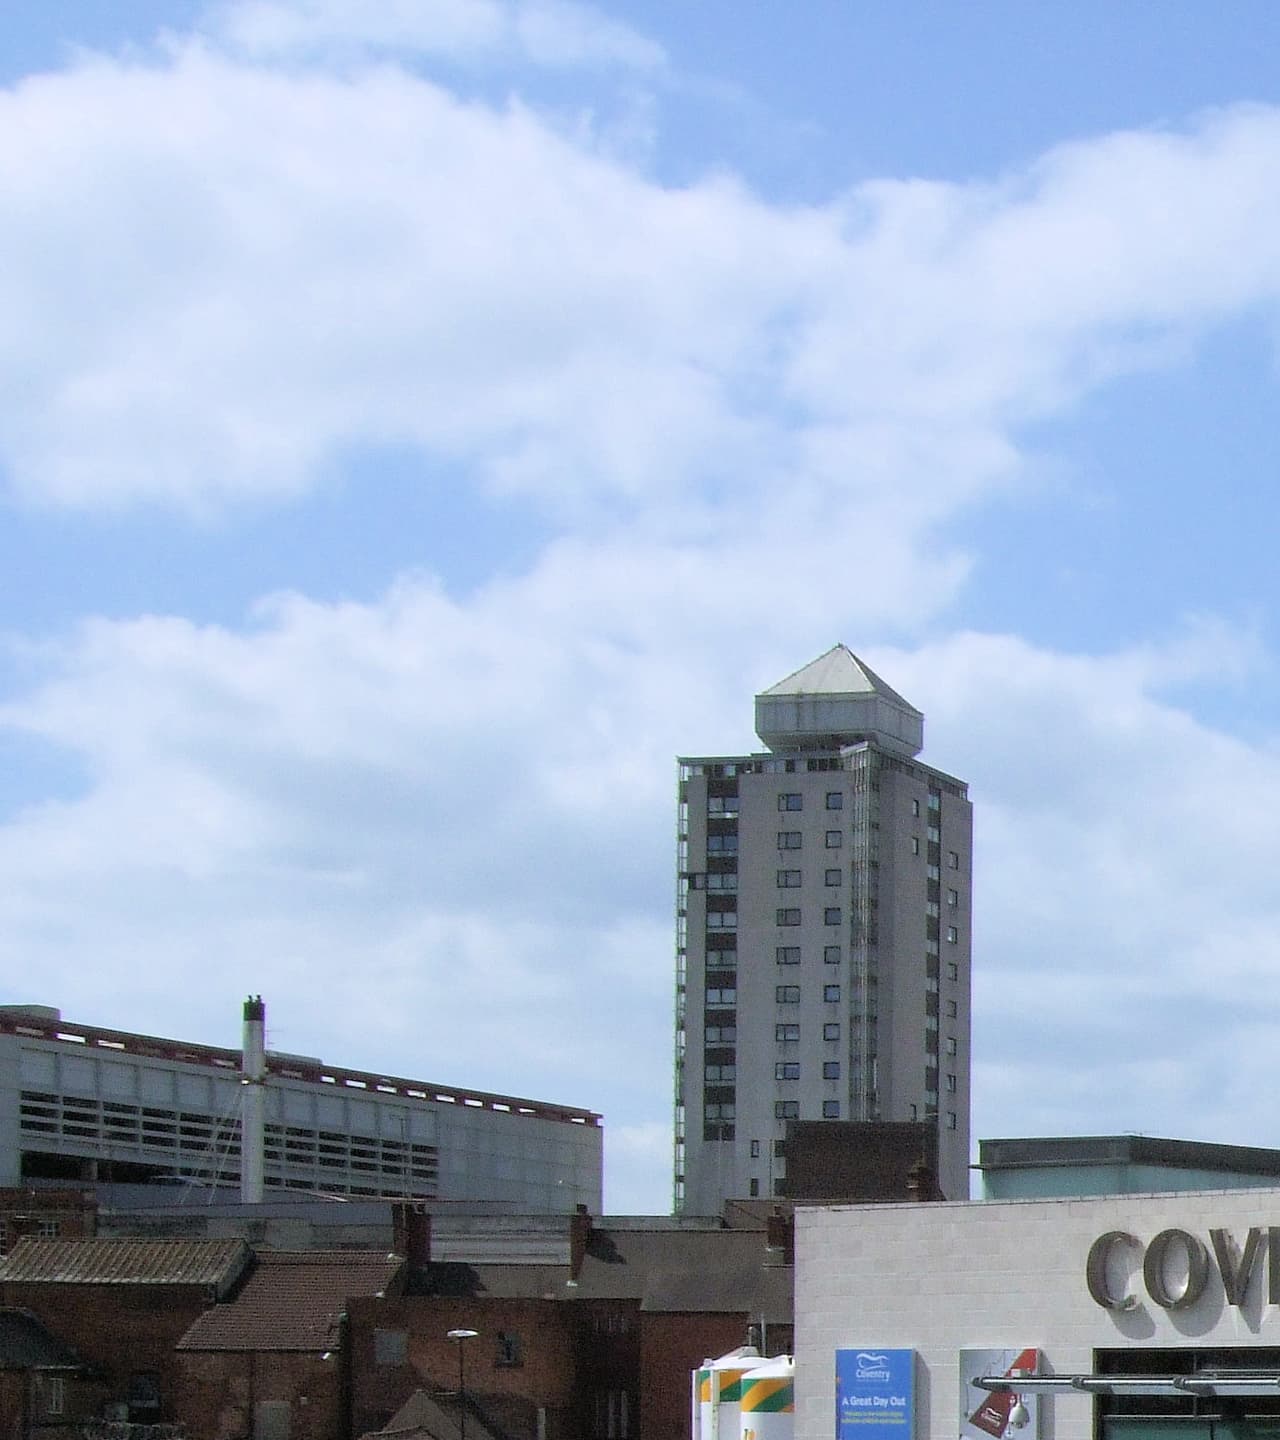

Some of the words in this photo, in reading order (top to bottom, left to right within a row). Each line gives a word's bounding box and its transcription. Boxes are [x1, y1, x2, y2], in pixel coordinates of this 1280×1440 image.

[856, 1369, 889, 1382] Coventry
[842, 1397, 849, 1406] A
[850, 1396, 872, 1406] Great
[873, 1396, 888, 1408] Day
[890, 1396, 906, 1406] Out
